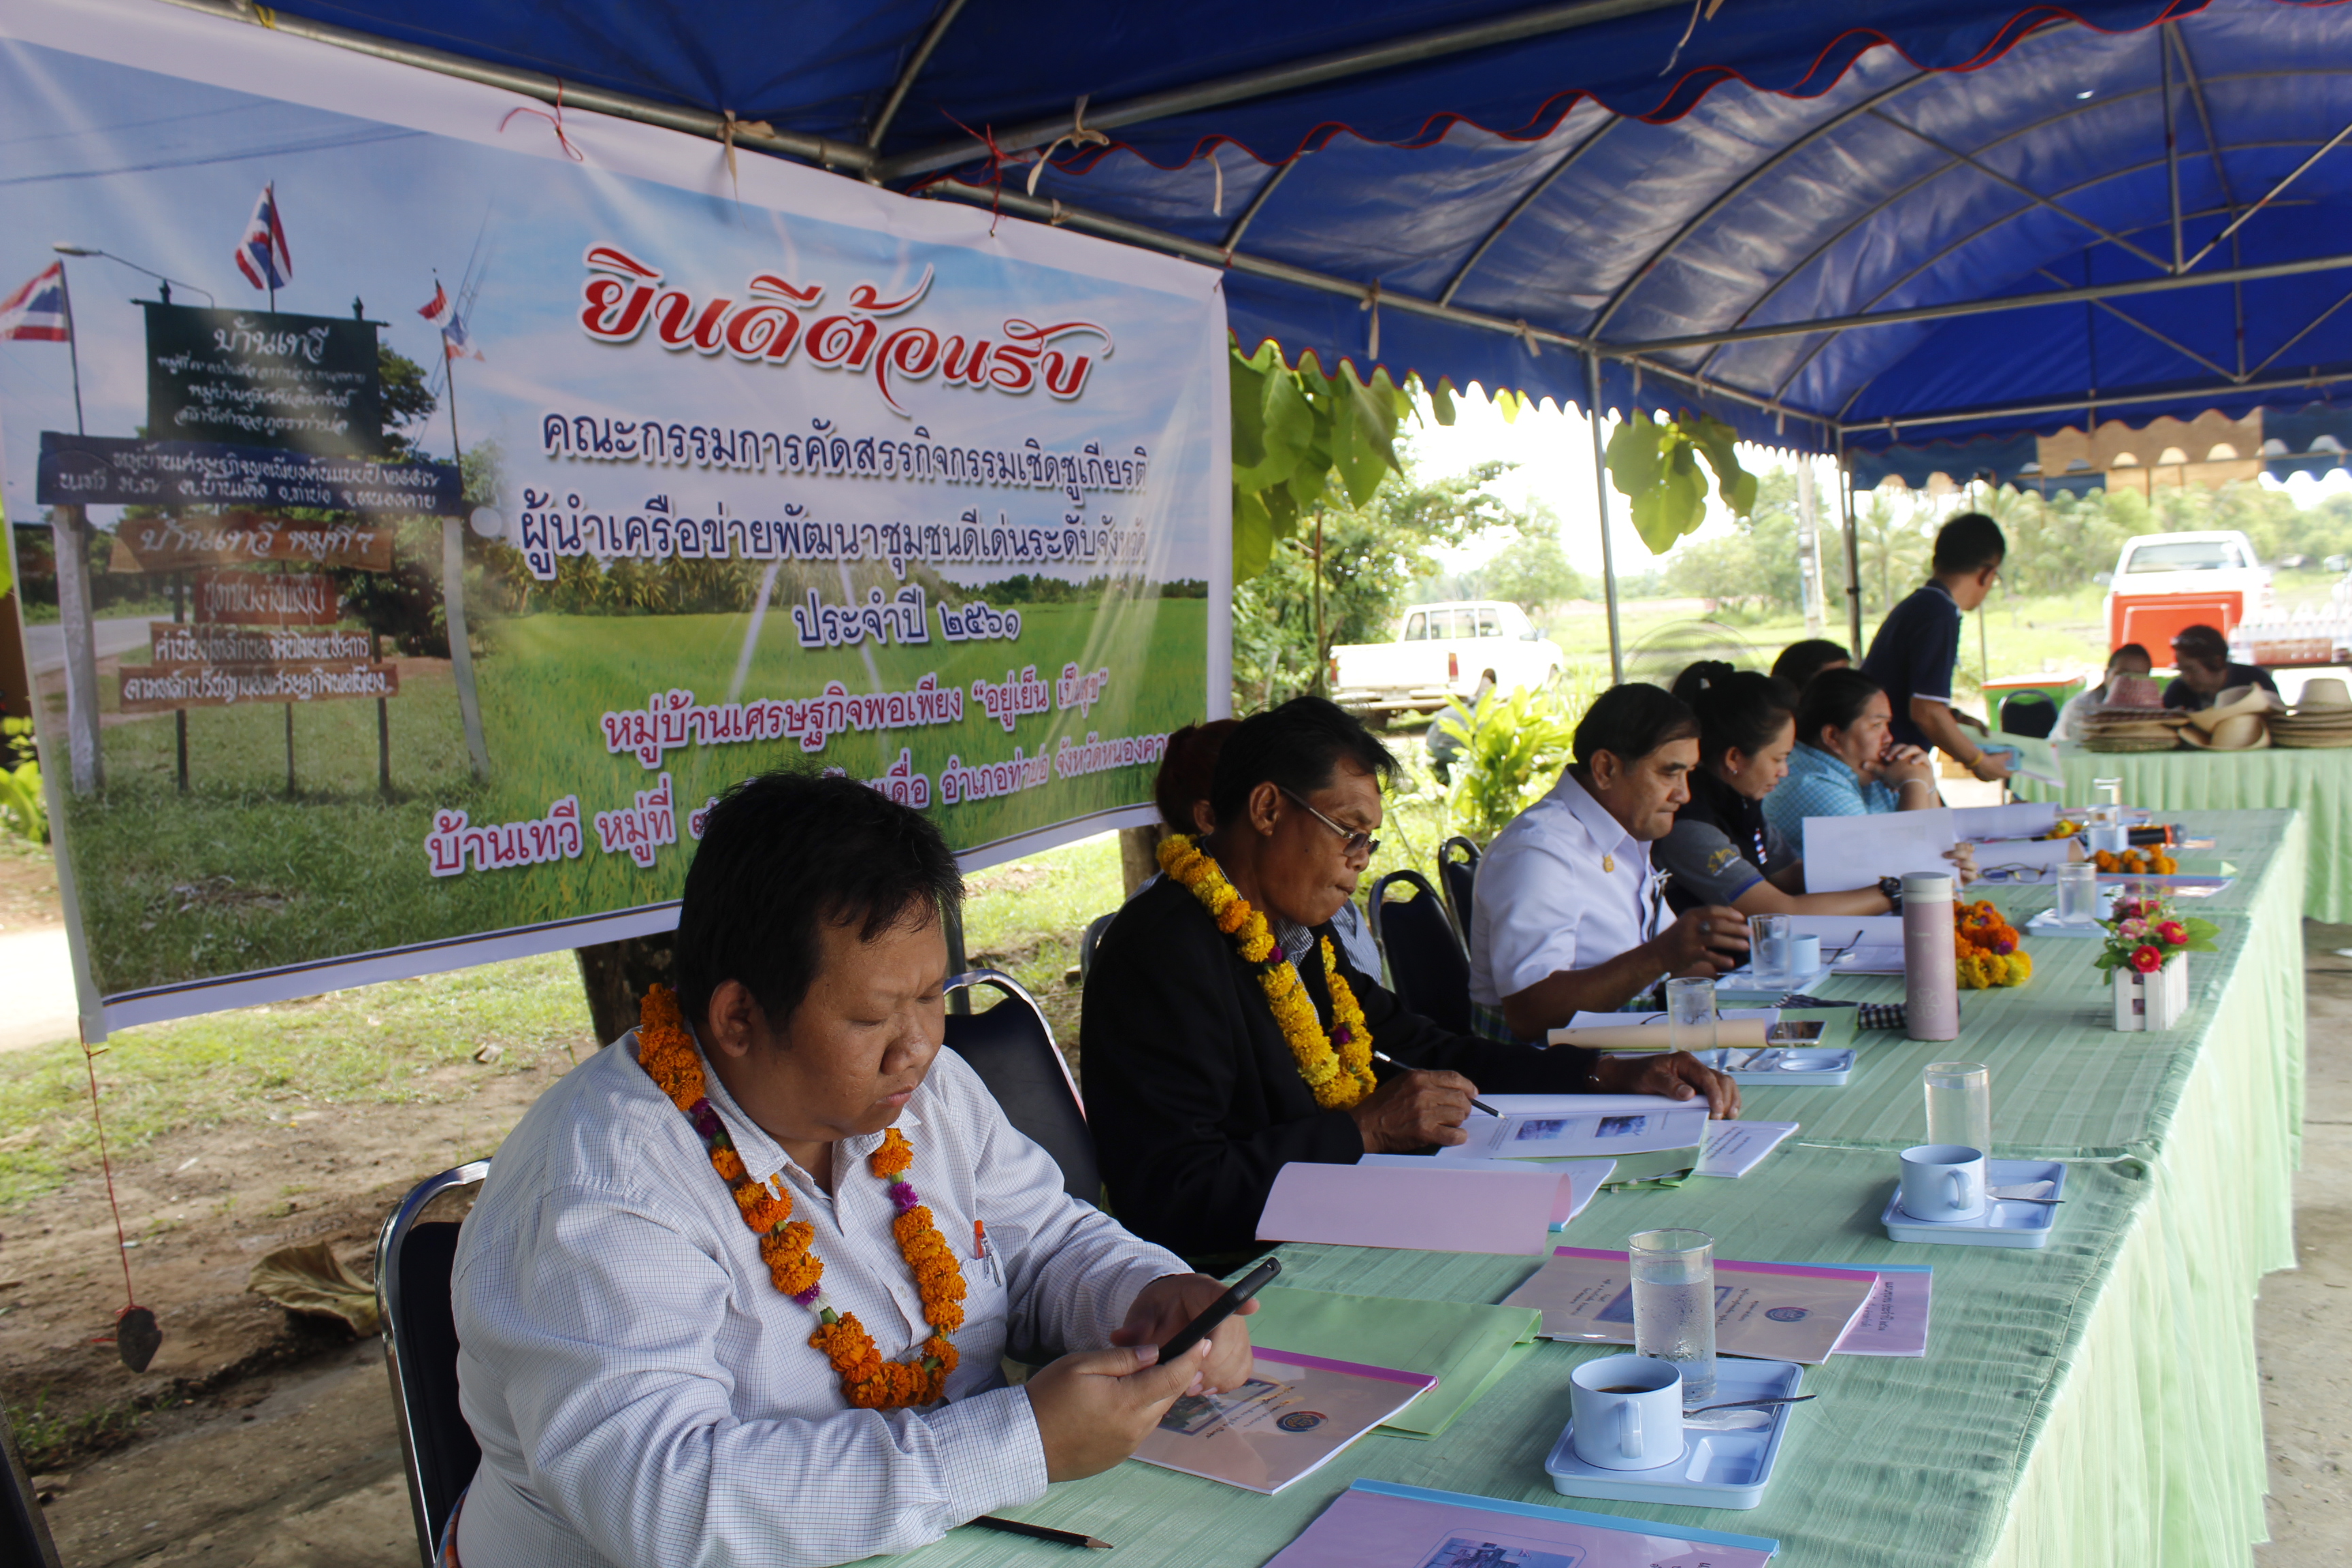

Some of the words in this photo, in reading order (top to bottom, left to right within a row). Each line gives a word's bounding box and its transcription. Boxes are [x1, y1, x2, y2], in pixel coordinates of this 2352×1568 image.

[582, 248, 1111, 412] ยินดีต้อนรับ
[544, 414, 1147, 501] คณะกรรมการคัดสรรกิจกรรมเชิดชูเกียรติ
[140, 520, 282, 557] บ้านเทวี
[796, 587, 923, 643] ประจำปี
[941, 603, 1020, 639] ๒๕๖๑
[606, 676, 961, 766] หมู่บ้านเศรษฐกิจพอเพียง
[429, 798, 579, 872] บ้านเทวี
[598, 778, 673, 864] หมู่ที่
[1056, 734, 1169, 776] จังหวัดหนองคา
